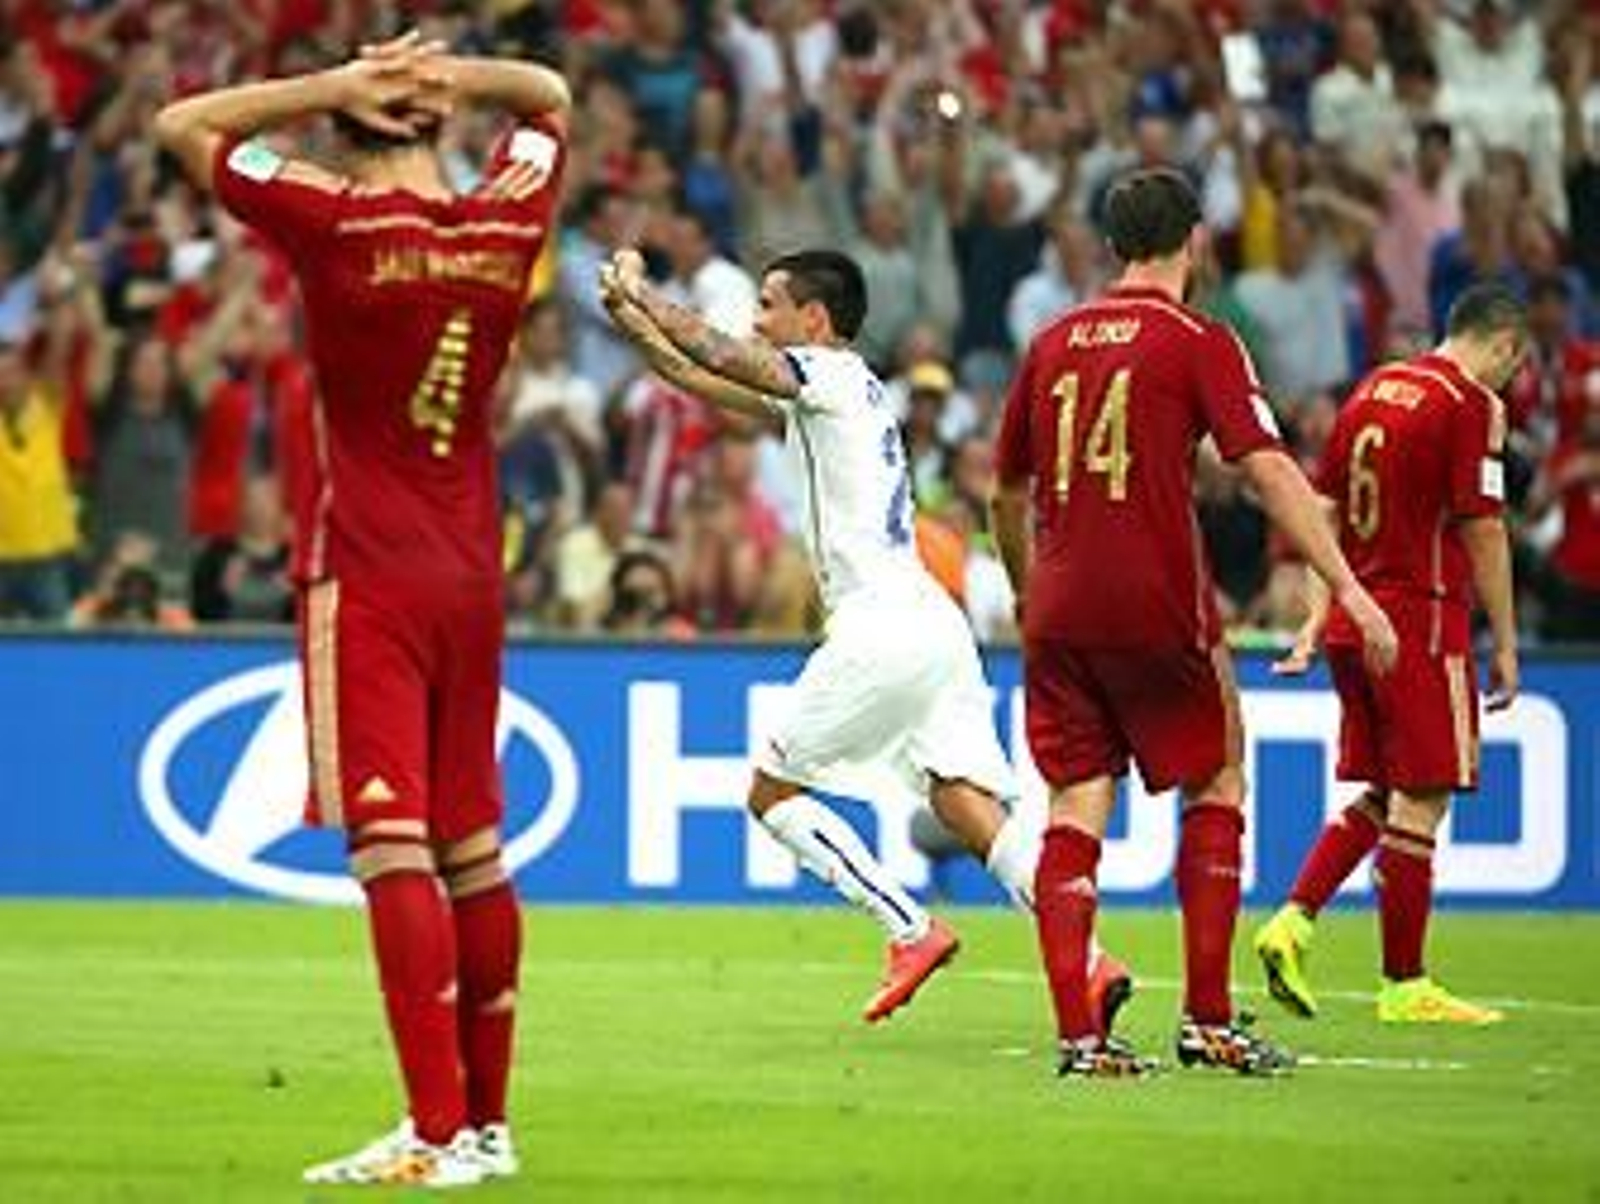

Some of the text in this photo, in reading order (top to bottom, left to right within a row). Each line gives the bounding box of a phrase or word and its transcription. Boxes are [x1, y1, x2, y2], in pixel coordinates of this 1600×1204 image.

[410, 308, 472, 457] 4
[1051, 369, 1131, 504] 14
[1349, 424, 1385, 540] 6
